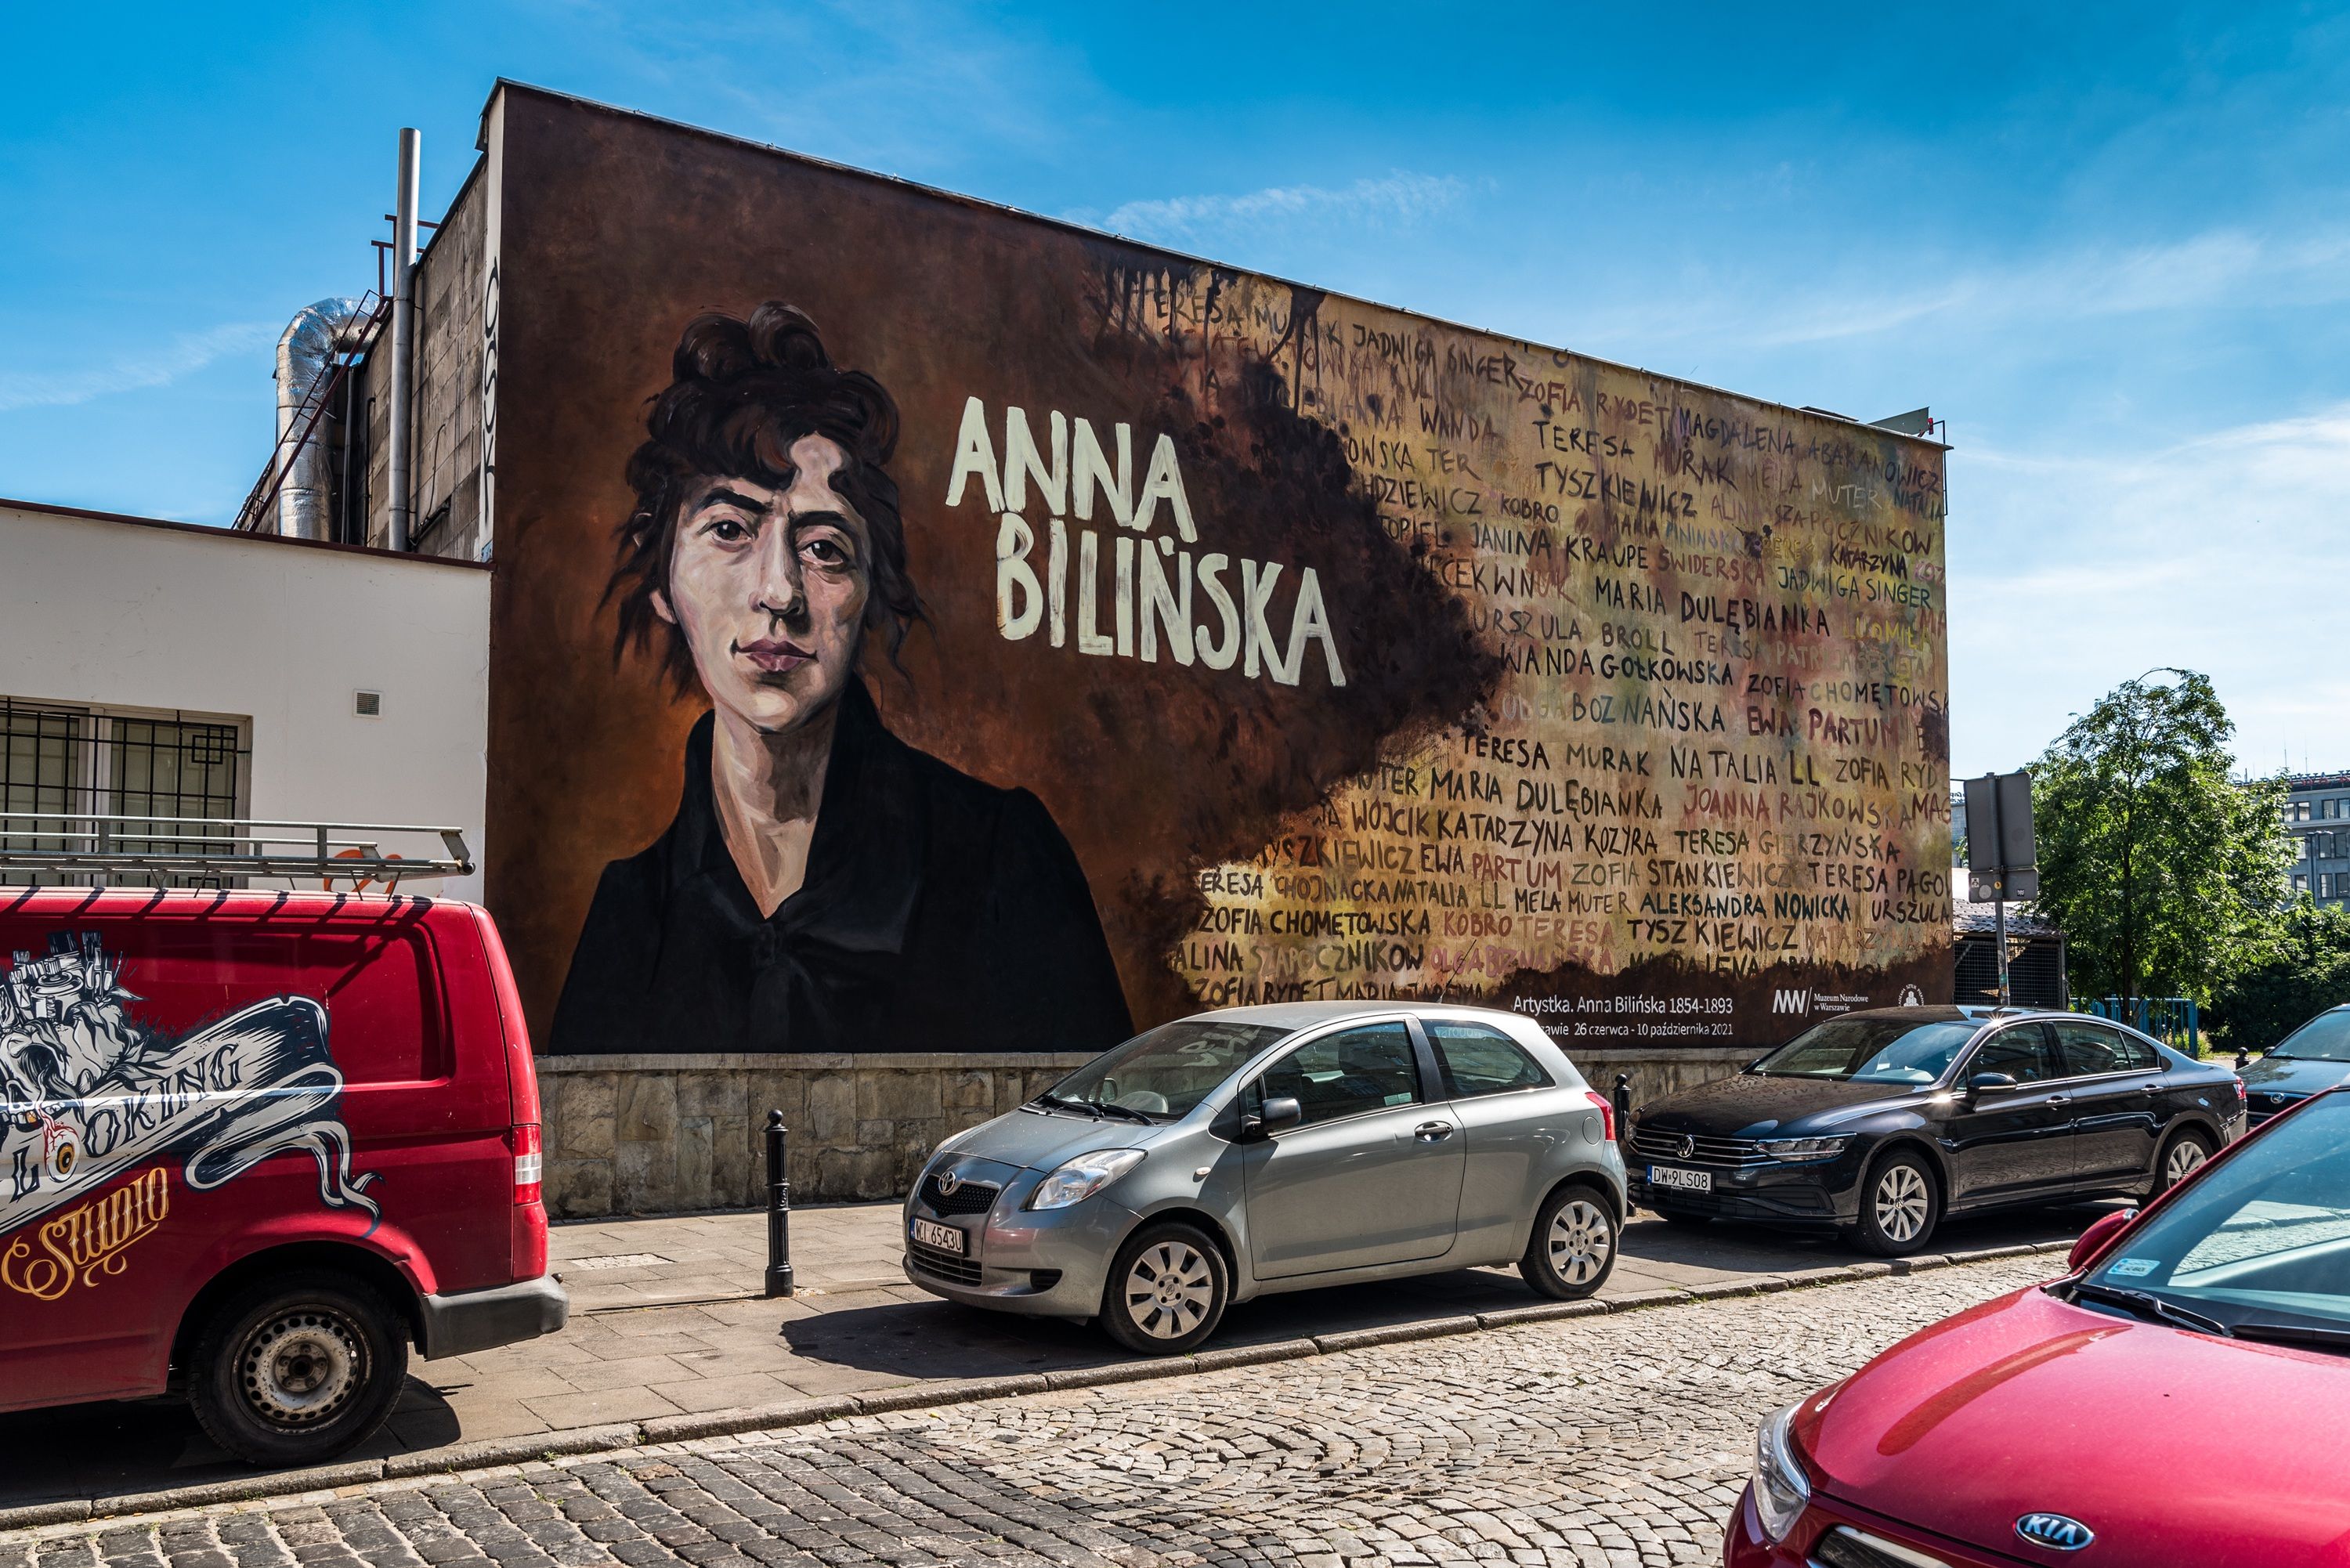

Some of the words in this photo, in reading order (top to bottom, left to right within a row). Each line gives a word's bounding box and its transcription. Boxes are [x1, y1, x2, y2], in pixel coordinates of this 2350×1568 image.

[1353, 323, 1436, 363] JADWIGA
[1449, 343, 1523, 390] SINGER
[1518, 378, 1582, 414] ZOFIA
[1678, 406, 1794, 455] MAGDALENA
[945, 396, 1197, 543] ANNA
[1532, 421, 1635, 463] TERESA
[1812, 477, 1882, 509] MUTER
[1535, 461, 1697, 517] TYSZKIEWICZ
[1501, 493, 1559, 523] KOBRO
[1470, 522, 1551, 558] JANINA
[1567, 535, 1649, 569] KRAUPE
[1830, 543, 1907, 580] KATARZYNA
[996, 512, 1346, 686] BILIŃSKA
[1495, 565, 1575, 605] WNUK
[1596, 576, 1666, 615] MARIA
[1681, 591, 1830, 637] DULĘBIANKA
[1778, 566, 1860, 602] JADWIGA
[1866, 579, 1931, 609] SINGER
[1473, 605, 1582, 642] URSZULA
[1602, 622, 1675, 656] BROLL
[1501, 642, 1595, 676] WANDA
[1600, 654, 1733, 685] GOŁKOWSKA
[1748, 674, 1805, 700] ZOFIA
[1503, 692, 1567, 721] OLGA
[1573, 687, 1725, 732] BOZNAŃSKA
[1747, 705, 1794, 737] EWA
[1809, 708, 1899, 748] PARTUM
[1463, 732, 1550, 771] TERESA
[1567, 742, 1650, 776] MURAK
[1671, 745, 1777, 784] NATALIA
[1790, 750, 1820, 786] LL
[1836, 757, 1889, 790] ZOFIA
[1357, 761, 1419, 796] UTER
[1430, 768, 1502, 804] MARIA
[1517, 779, 1662, 822] DULĘBIANKA
[1684, 784, 1770, 822] JOANNA
[1780, 791, 1911, 830] RAJKOWSKA
[1351, 796, 1430, 836] WÓJCIK
[1438, 810, 1572, 856] KATARZYNA
[1585, 823, 1658, 858] KOZYRA
[1674, 829, 1749, 855] TERESA
[1421, 844, 1465, 874] EWA
[1472, 853, 1562, 891] PARTUM
[1571, 862, 1640, 887] ZOFIA
[1649, 859, 1791, 890] STANKIEWICZ
[1808, 862, 1889, 894] TERESA
[1275, 875, 1390, 902] CHOJNACKA
[1394, 879, 1469, 908] NATALIA
[1480, 882, 1506, 909] LL
[1515, 887, 1561, 913] MELA
[1568, 891, 1632, 916] MUTER
[1640, 892, 1766, 919] ALEKSANDRA
[1775, 891, 1851, 923] NOWICKA
[1872, 899, 1949, 925] URSZULA
[1198, 906, 1262, 935] ZOFIA
[1270, 909, 1430, 939] CHOMĘTOWSKA
[1444, 910, 1513, 938] KOBRO
[1518, 916, 1614, 944] TERESA
[1806, 923, 1918, 951] KATARZNA
[1177, 941, 1244, 971] ALINA
[1431, 946, 1484, 974] OLGA
[1195, 977, 1256, 1007] ZOFIA
[1513, 995, 1573, 1016] Artystka.
[1577, 996, 1611, 1013] Anna
[1615, 993, 1665, 1013] Bilińska
[1669, 997, 1733, 1014] 1854-1893
[1814, 993, 1838, 1003] Muzeum
[1840, 993, 1868, 1003] Narodowe
[1820, 1003, 1850, 1011] Warszawie
[1574, 1023, 1587, 1035] 26
[1589, 1026, 1629, 1035] czerwca
[1637, 1024, 1648, 1035] 10
[1650, 1022, 1709, 1038] października
[1712, 1024, 1733, 1035] 2021
[1654, 1168, 1668, 1183] DW
[1672, 1170, 1708, 1189] 9LS08
[2, 1167, 169, 1300] STUDIO
[2024, 1516, 2077, 1545] KIA
